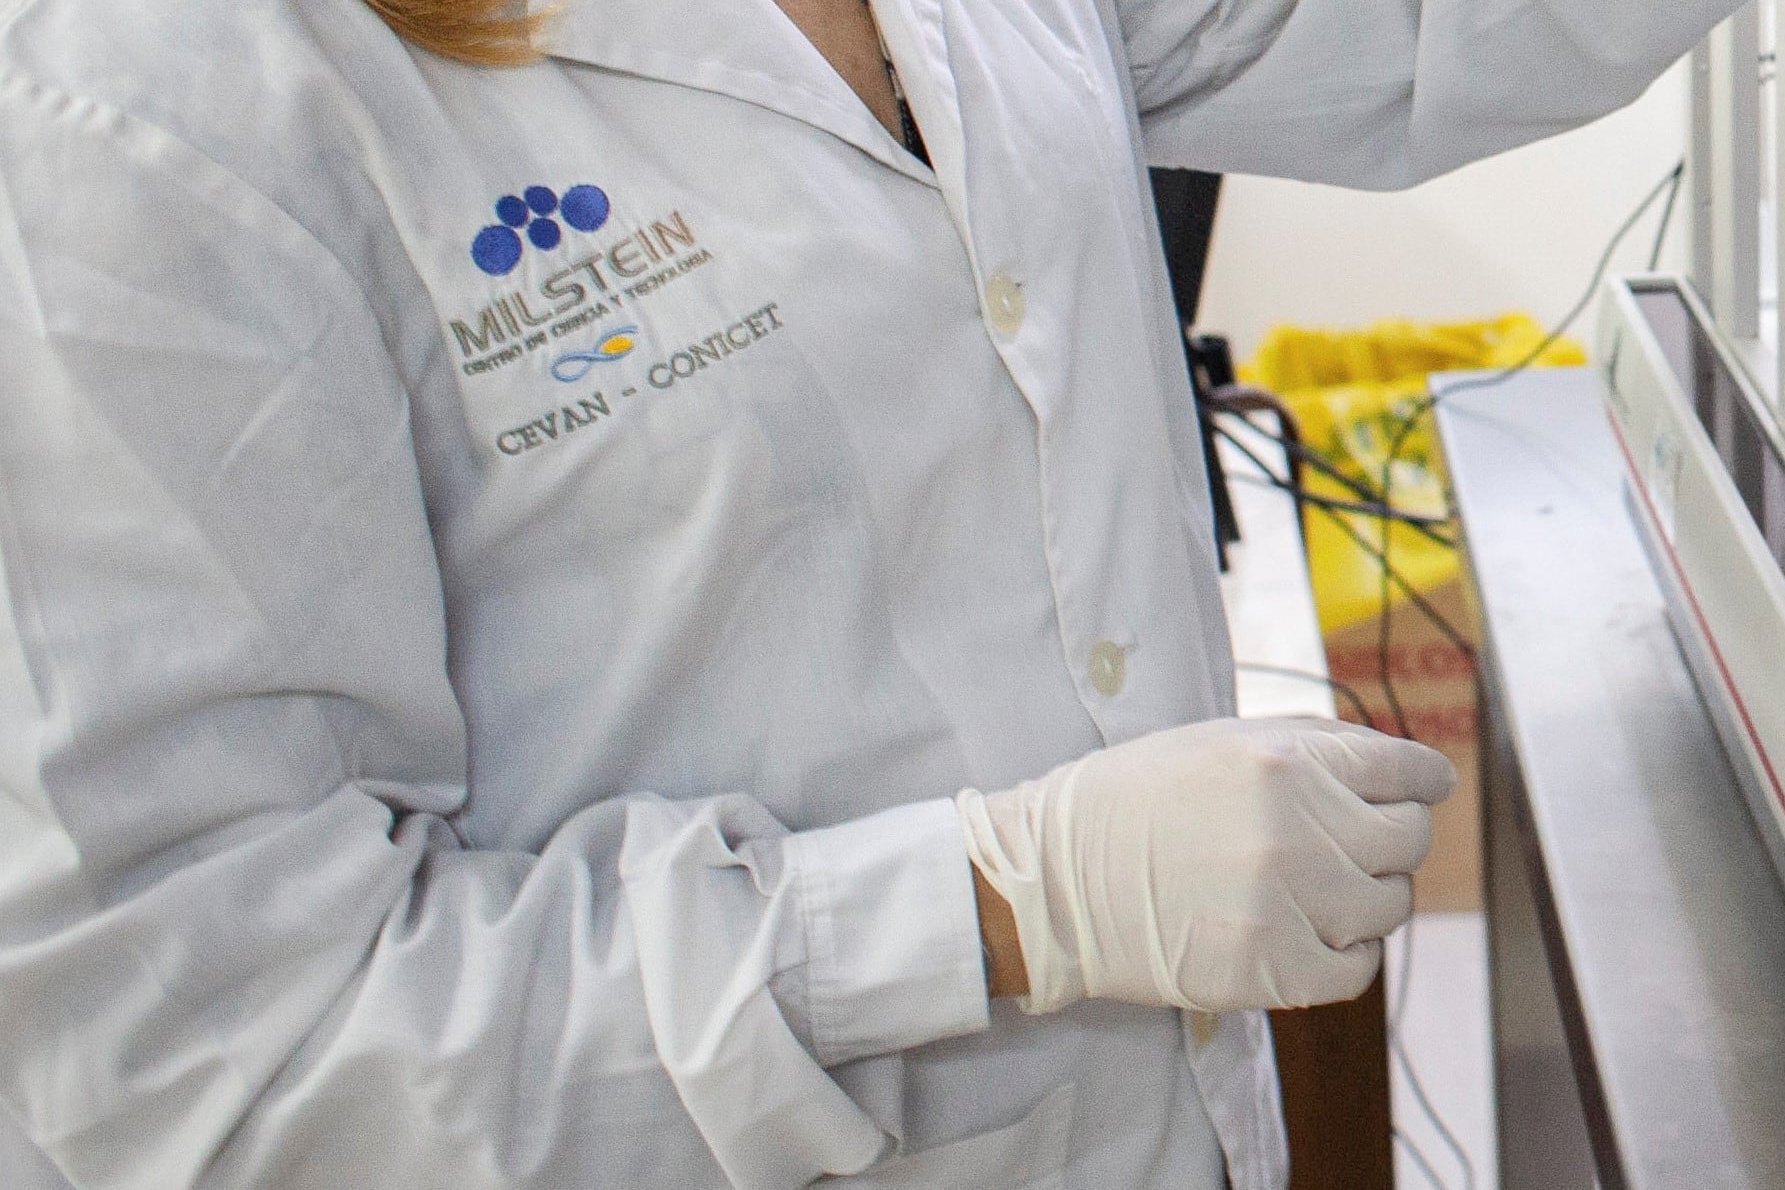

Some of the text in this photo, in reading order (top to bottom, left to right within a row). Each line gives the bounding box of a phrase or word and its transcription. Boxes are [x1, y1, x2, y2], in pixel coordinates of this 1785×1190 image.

[449, 210, 696, 358] MILSTEIN
[463, 344, 523, 377] CENTRO
[609, 293, 623, 308] Y
[497, 392, 612, 455] CEVAN
[648, 303, 784, 390] CONICET
